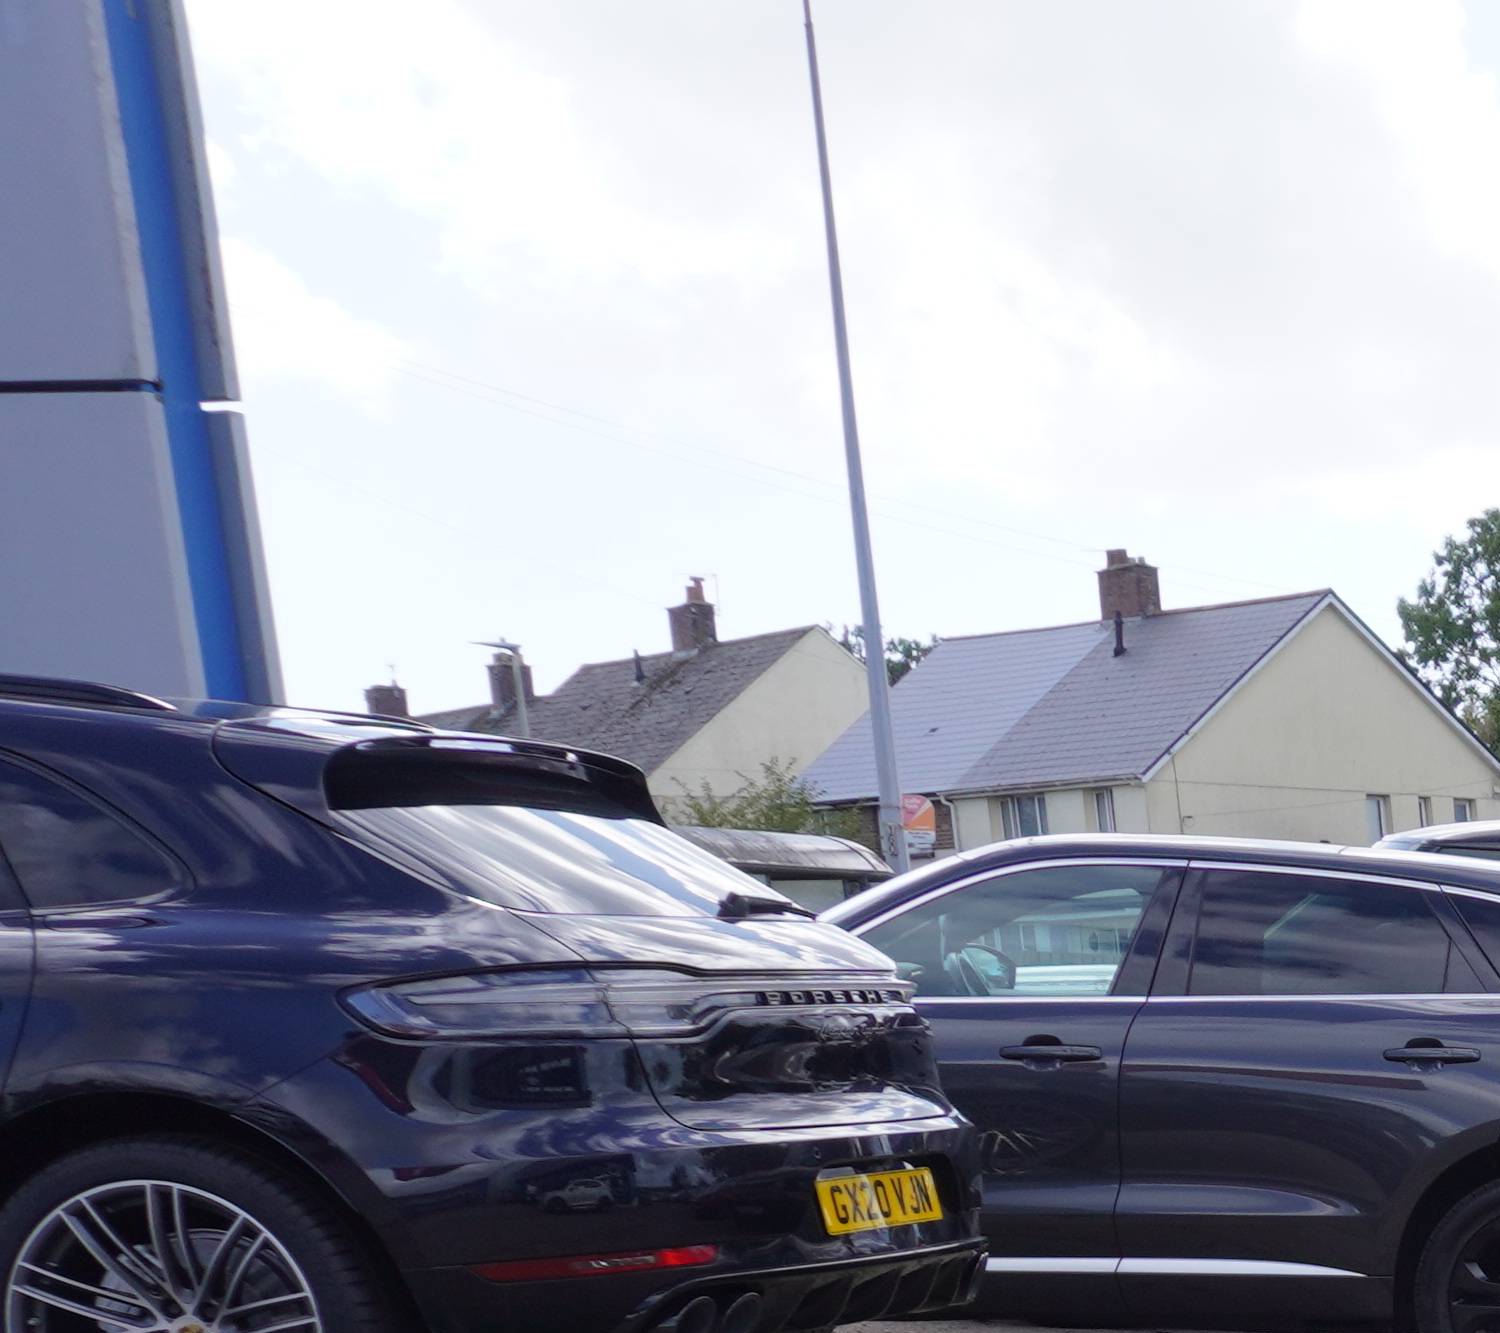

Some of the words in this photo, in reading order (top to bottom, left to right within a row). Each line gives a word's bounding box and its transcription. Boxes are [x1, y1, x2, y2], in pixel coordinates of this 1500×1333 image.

[765, 990, 889, 1005] PORSCHE
[829, 1179, 891, 1225] GX20
[892, 1174, 934, 1215] VJN
